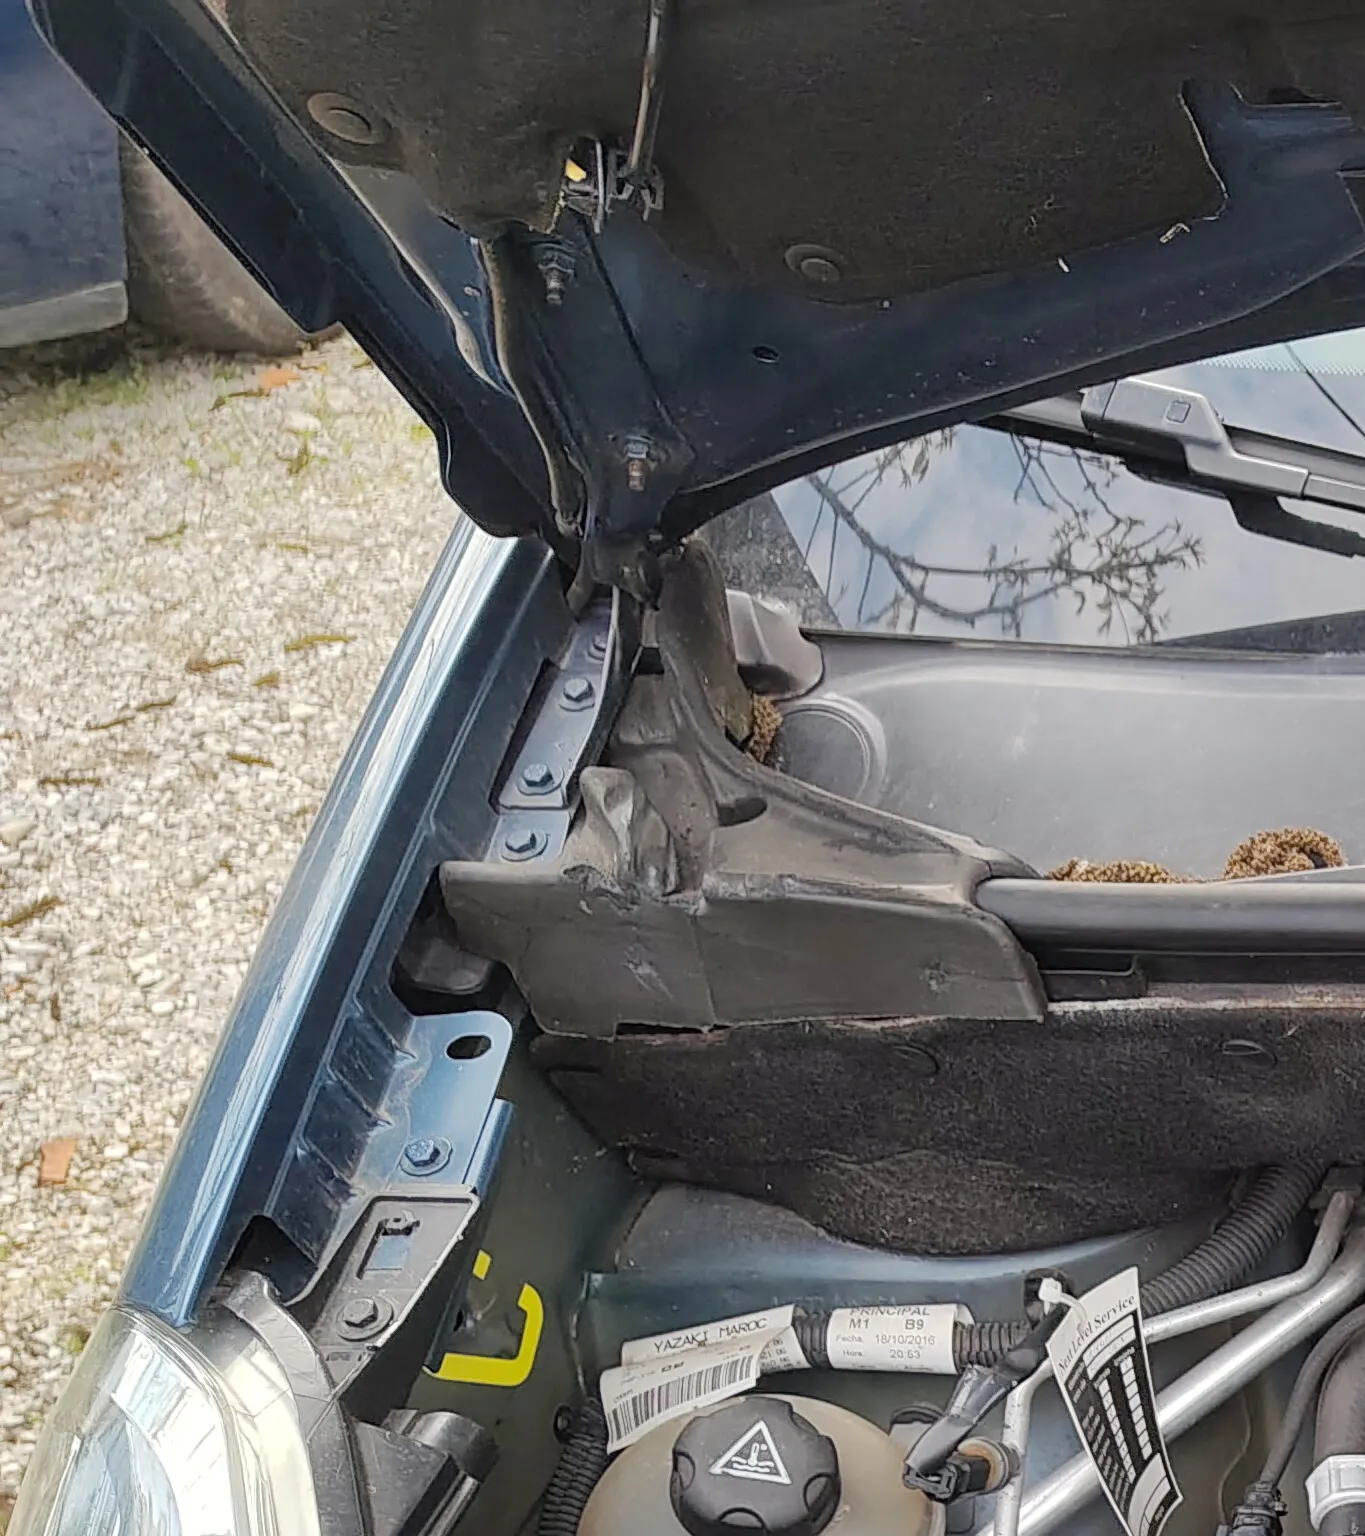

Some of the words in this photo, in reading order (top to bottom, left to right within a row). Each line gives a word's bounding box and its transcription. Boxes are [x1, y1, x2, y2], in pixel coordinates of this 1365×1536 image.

[849, 1318, 870, 1330] M1
[904, 1318, 925, 1331] B9
[653, 1330, 710, 1354] YAZAKI
[719, 1317, 768, 1338] MAROC
[875, 1334, 936, 1346] 18/10/2016
